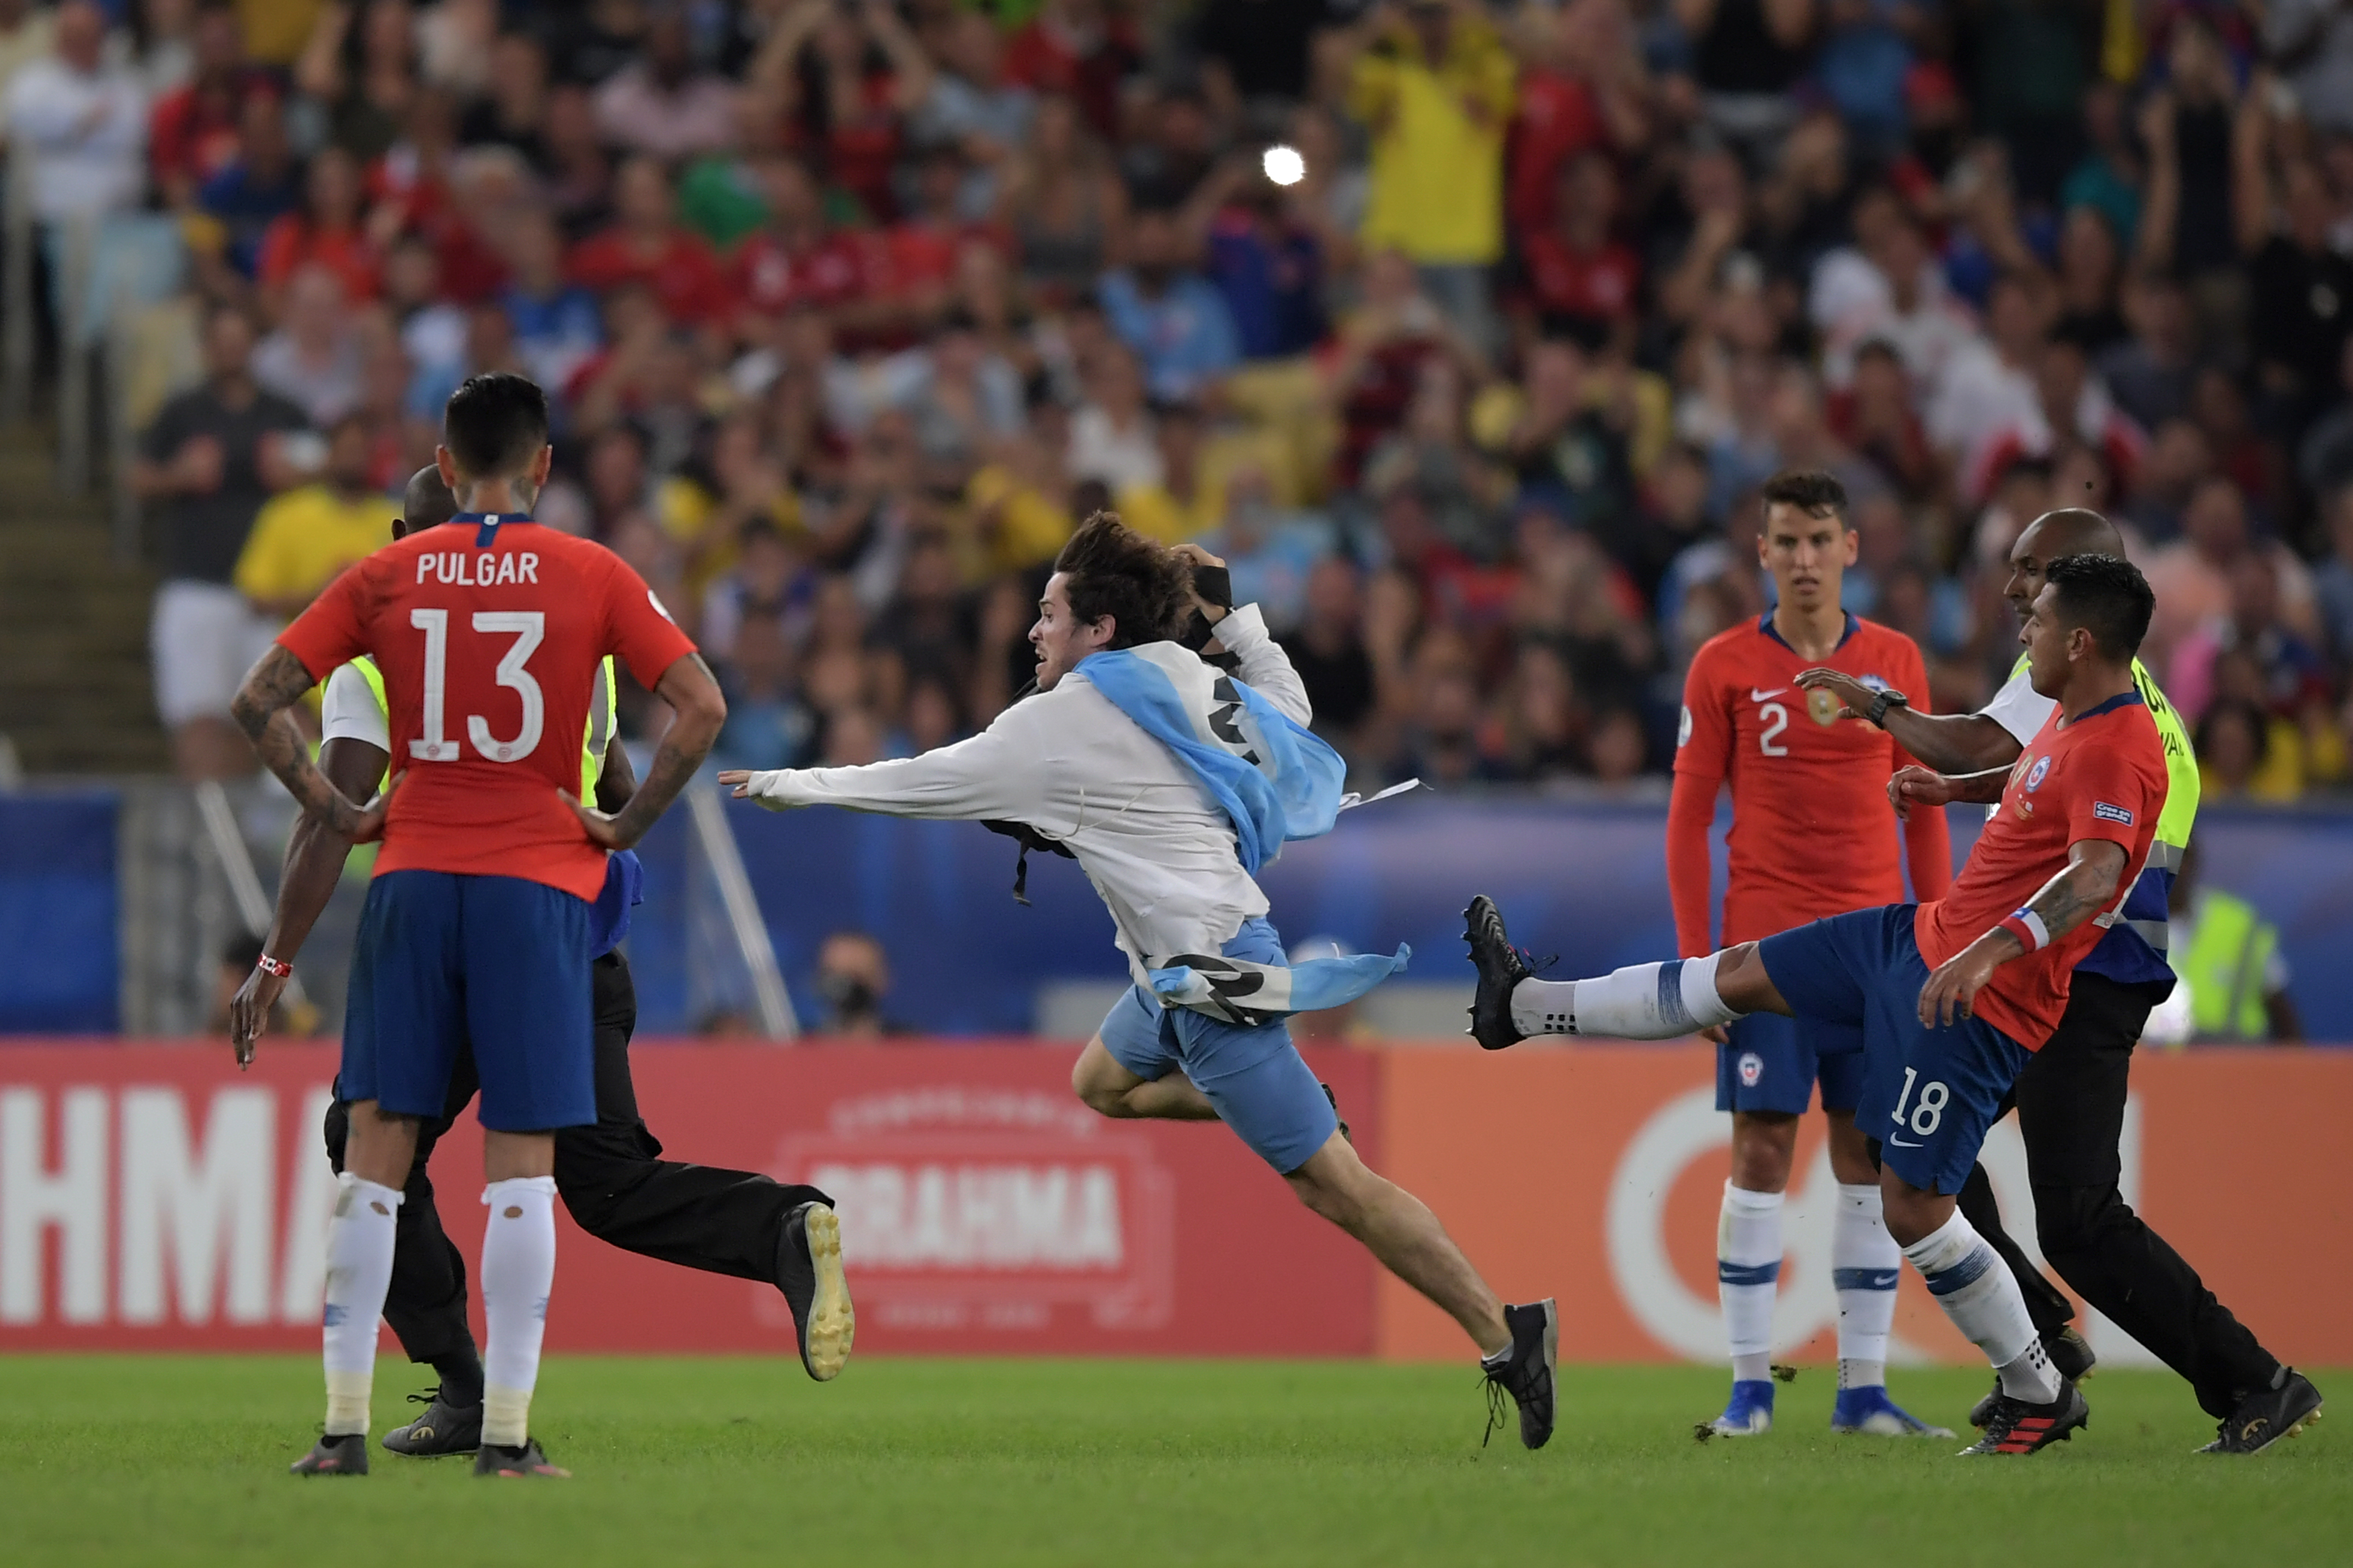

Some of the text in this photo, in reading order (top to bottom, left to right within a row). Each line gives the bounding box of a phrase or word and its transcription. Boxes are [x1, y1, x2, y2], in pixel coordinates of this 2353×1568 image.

[416, 552, 539, 586] PULGAR
[407, 608, 545, 764] 13
[1759, 702, 1788, 756] 2
[1891, 1066, 1949, 1135] 18
